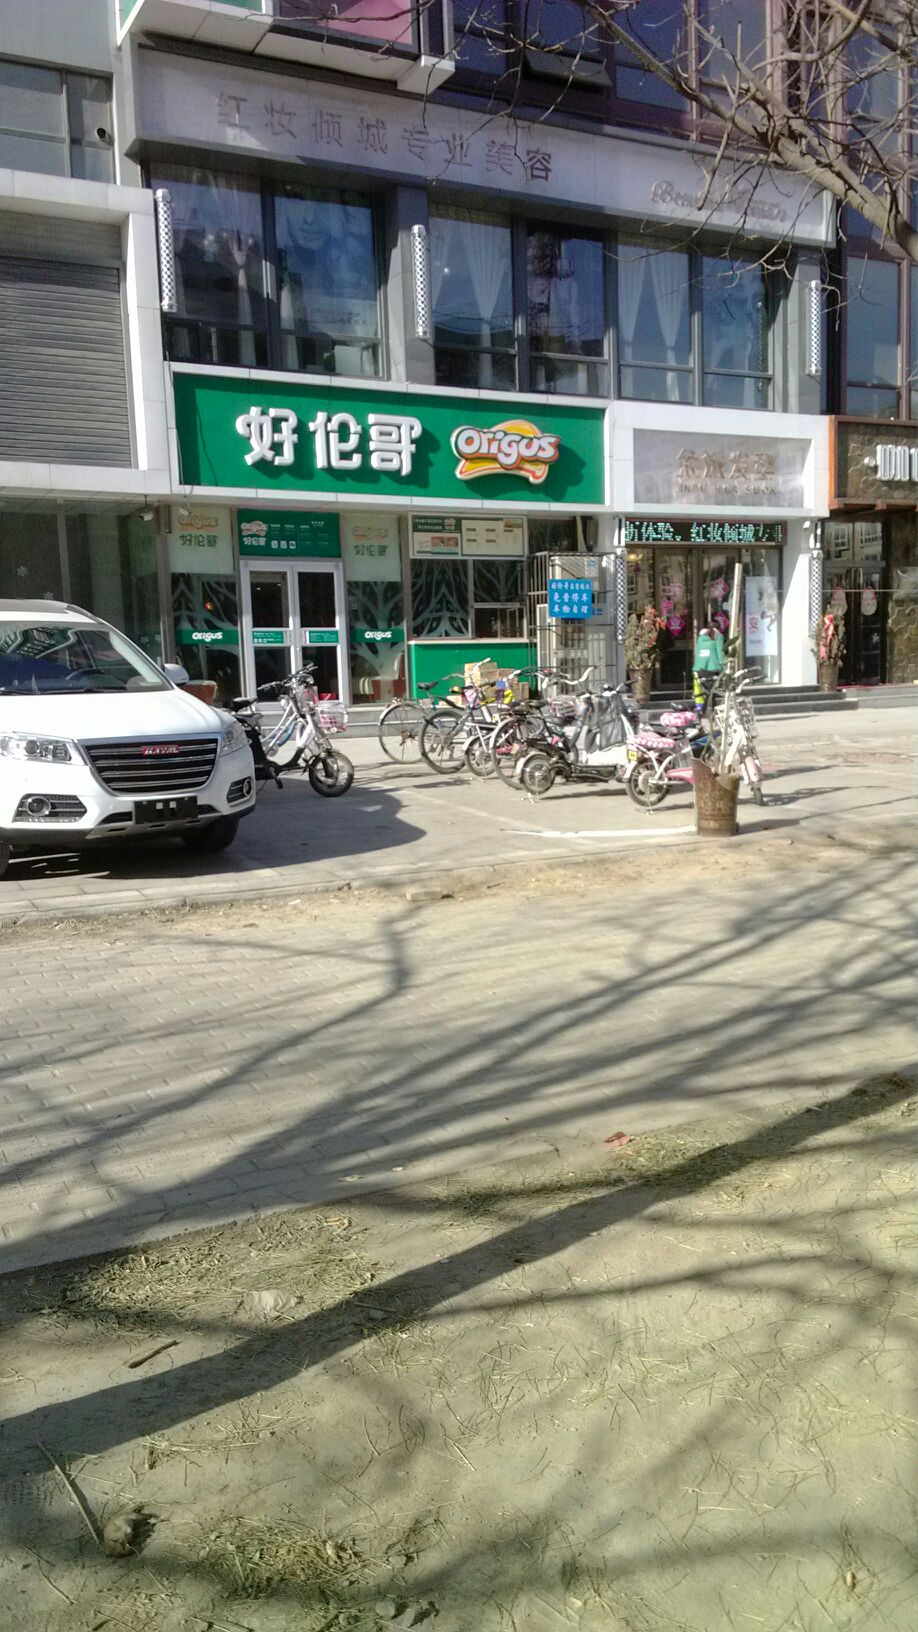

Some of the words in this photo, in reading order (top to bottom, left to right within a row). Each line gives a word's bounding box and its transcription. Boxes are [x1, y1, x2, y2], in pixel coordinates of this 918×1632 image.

[216, 90, 553, 182] 红妆倾城专业美容
[235, 405, 423, 477] 好伦哥
[455, 427, 560, 468] Origus
